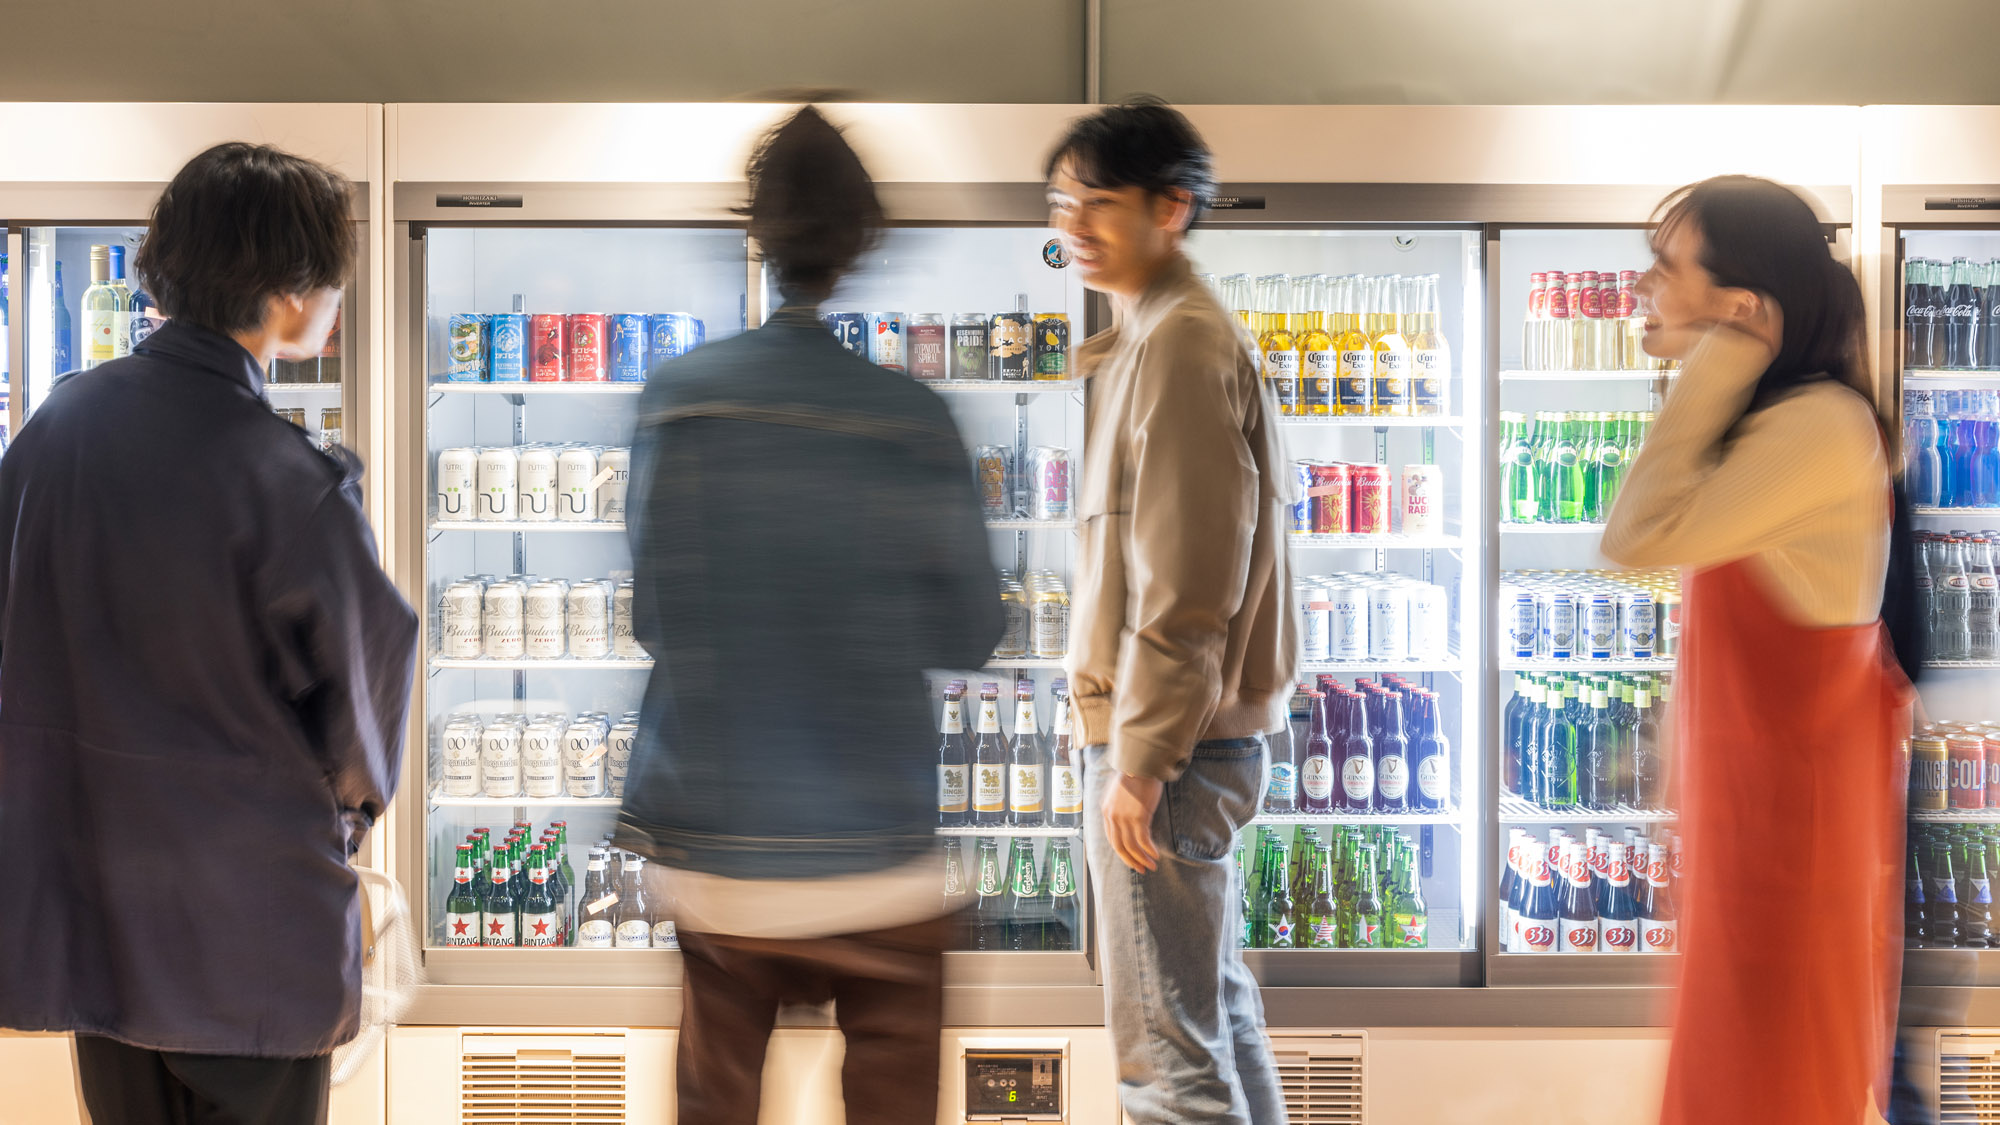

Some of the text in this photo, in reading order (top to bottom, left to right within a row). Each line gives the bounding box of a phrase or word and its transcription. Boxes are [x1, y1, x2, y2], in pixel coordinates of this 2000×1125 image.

[1906, 304, 1936, 317] Coca-Co
[1942, 304, 1973, 317] oca-Cola
[914, 343, 941, 353] HYPNOTIC
[957, 336, 984, 347] PRIDE
[918, 353, 938, 363] SPIRAL
[979, 457, 1005, 471] GOL
[1044, 460, 1068, 474] AM
[980, 471, 1004, 484] DEN
[1044, 473, 1069, 488] BER
[1408, 496, 1428, 505] LUC
[1408, 505, 1429, 514] RAB
[1304, 773, 1329, 781] GUINNES
[1950, 758, 1986, 791] COLA
[983, 860, 997, 893] Carlsberg
[1022, 861, 1034, 894] Carlsberg
[1056, 861, 1069, 894] Carlsberg
[446, 936, 478, 945] BINTANG
[483, 936, 513, 945] BINTANG
[524, 936, 556, 945] BINTANG
[1528, 925, 1550, 944] 333
[1573, 926, 1594, 945] 333
[1610, 925, 1632, 944] 333
[1650, 926, 1672, 945] 333
[1008, 1090, 1018, 1102] 6
